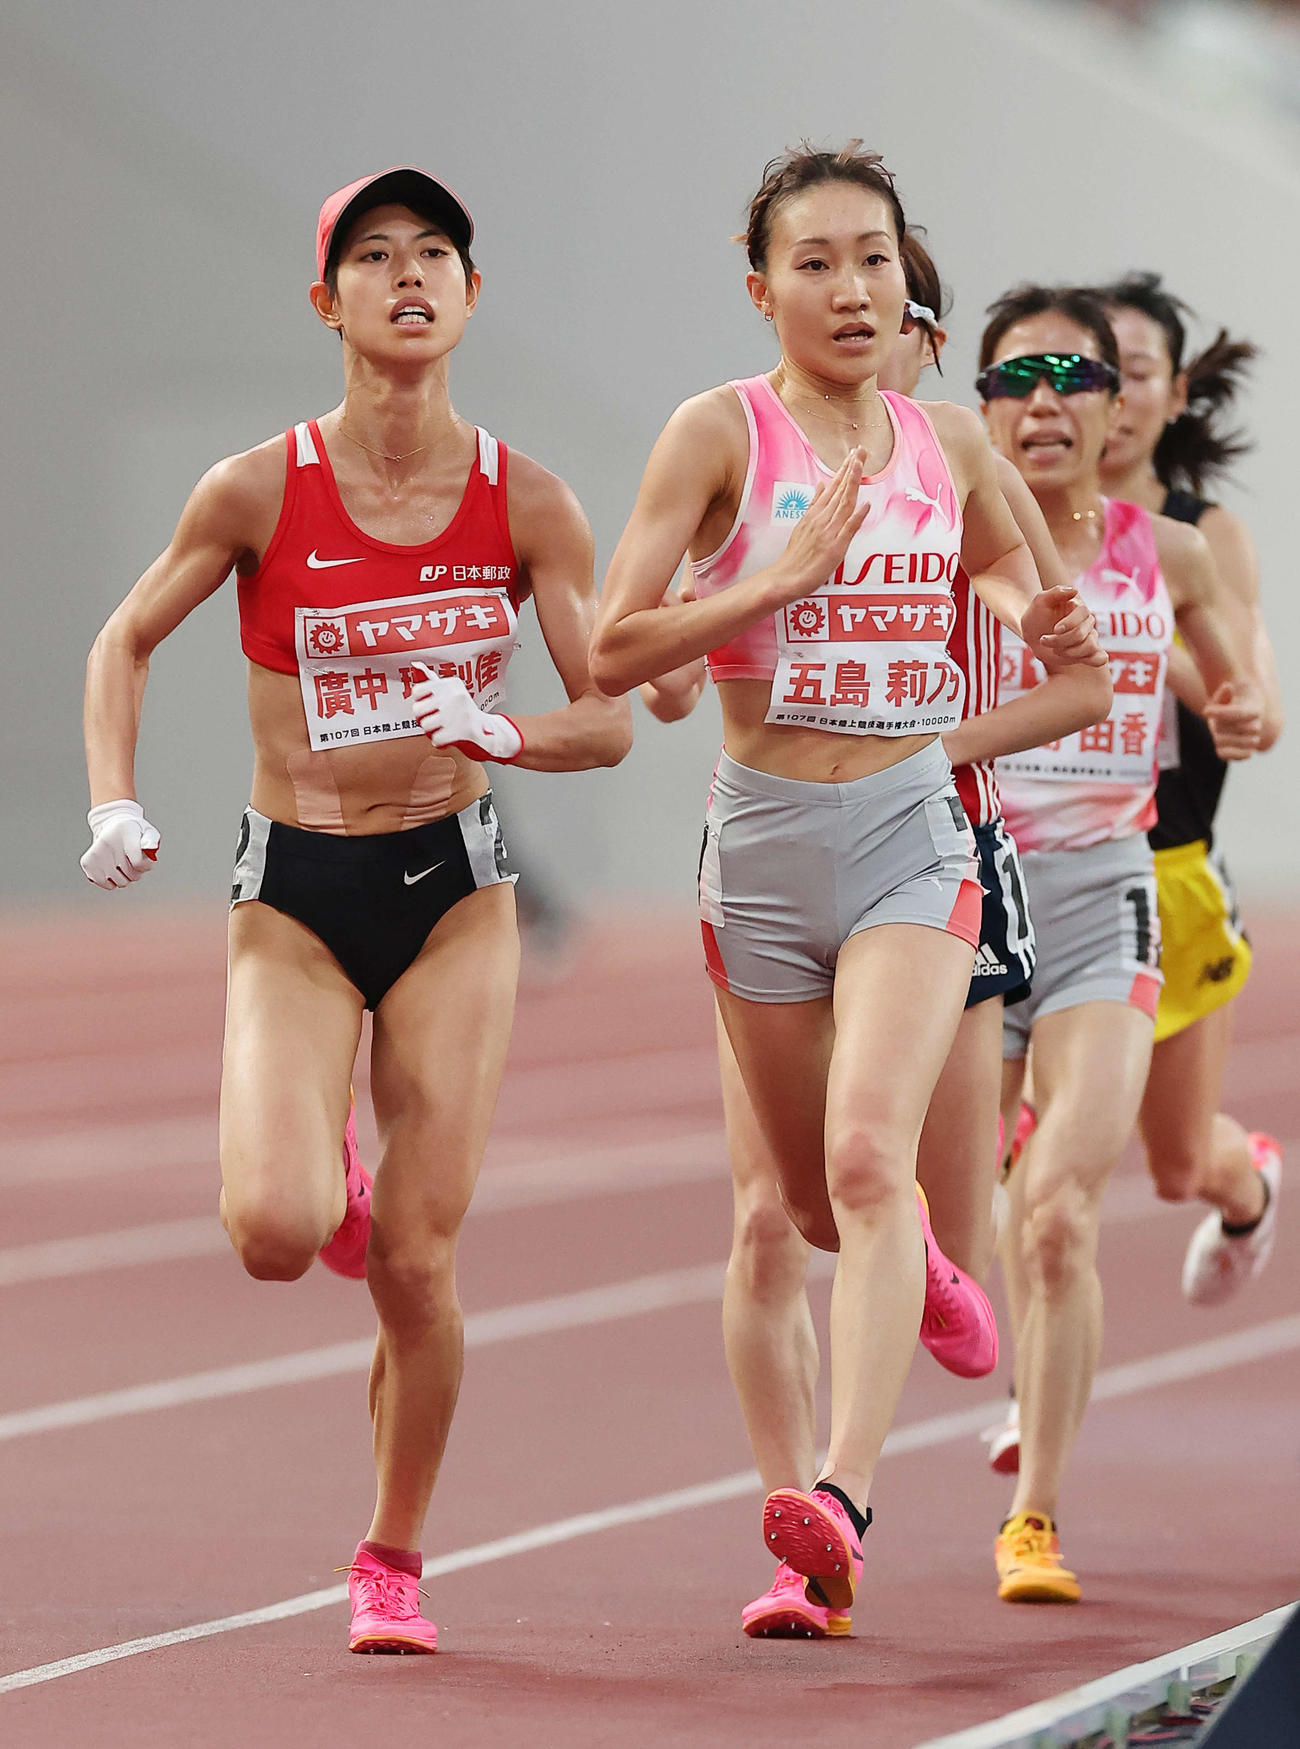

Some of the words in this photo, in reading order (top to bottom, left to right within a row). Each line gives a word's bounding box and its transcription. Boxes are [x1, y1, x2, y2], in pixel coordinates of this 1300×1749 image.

[420, 565, 447, 581] JP
[453, 565, 511, 581] 日本郵政
[356, 604, 498, 647] ヤマザキ
[313, 667, 389, 720] 廣中
[783, 659, 870, 709] 五島
[885, 659, 959, 708] 莉乃
[320, 728, 360, 742] 第107回
[971, 963, 1009, 977] didas
